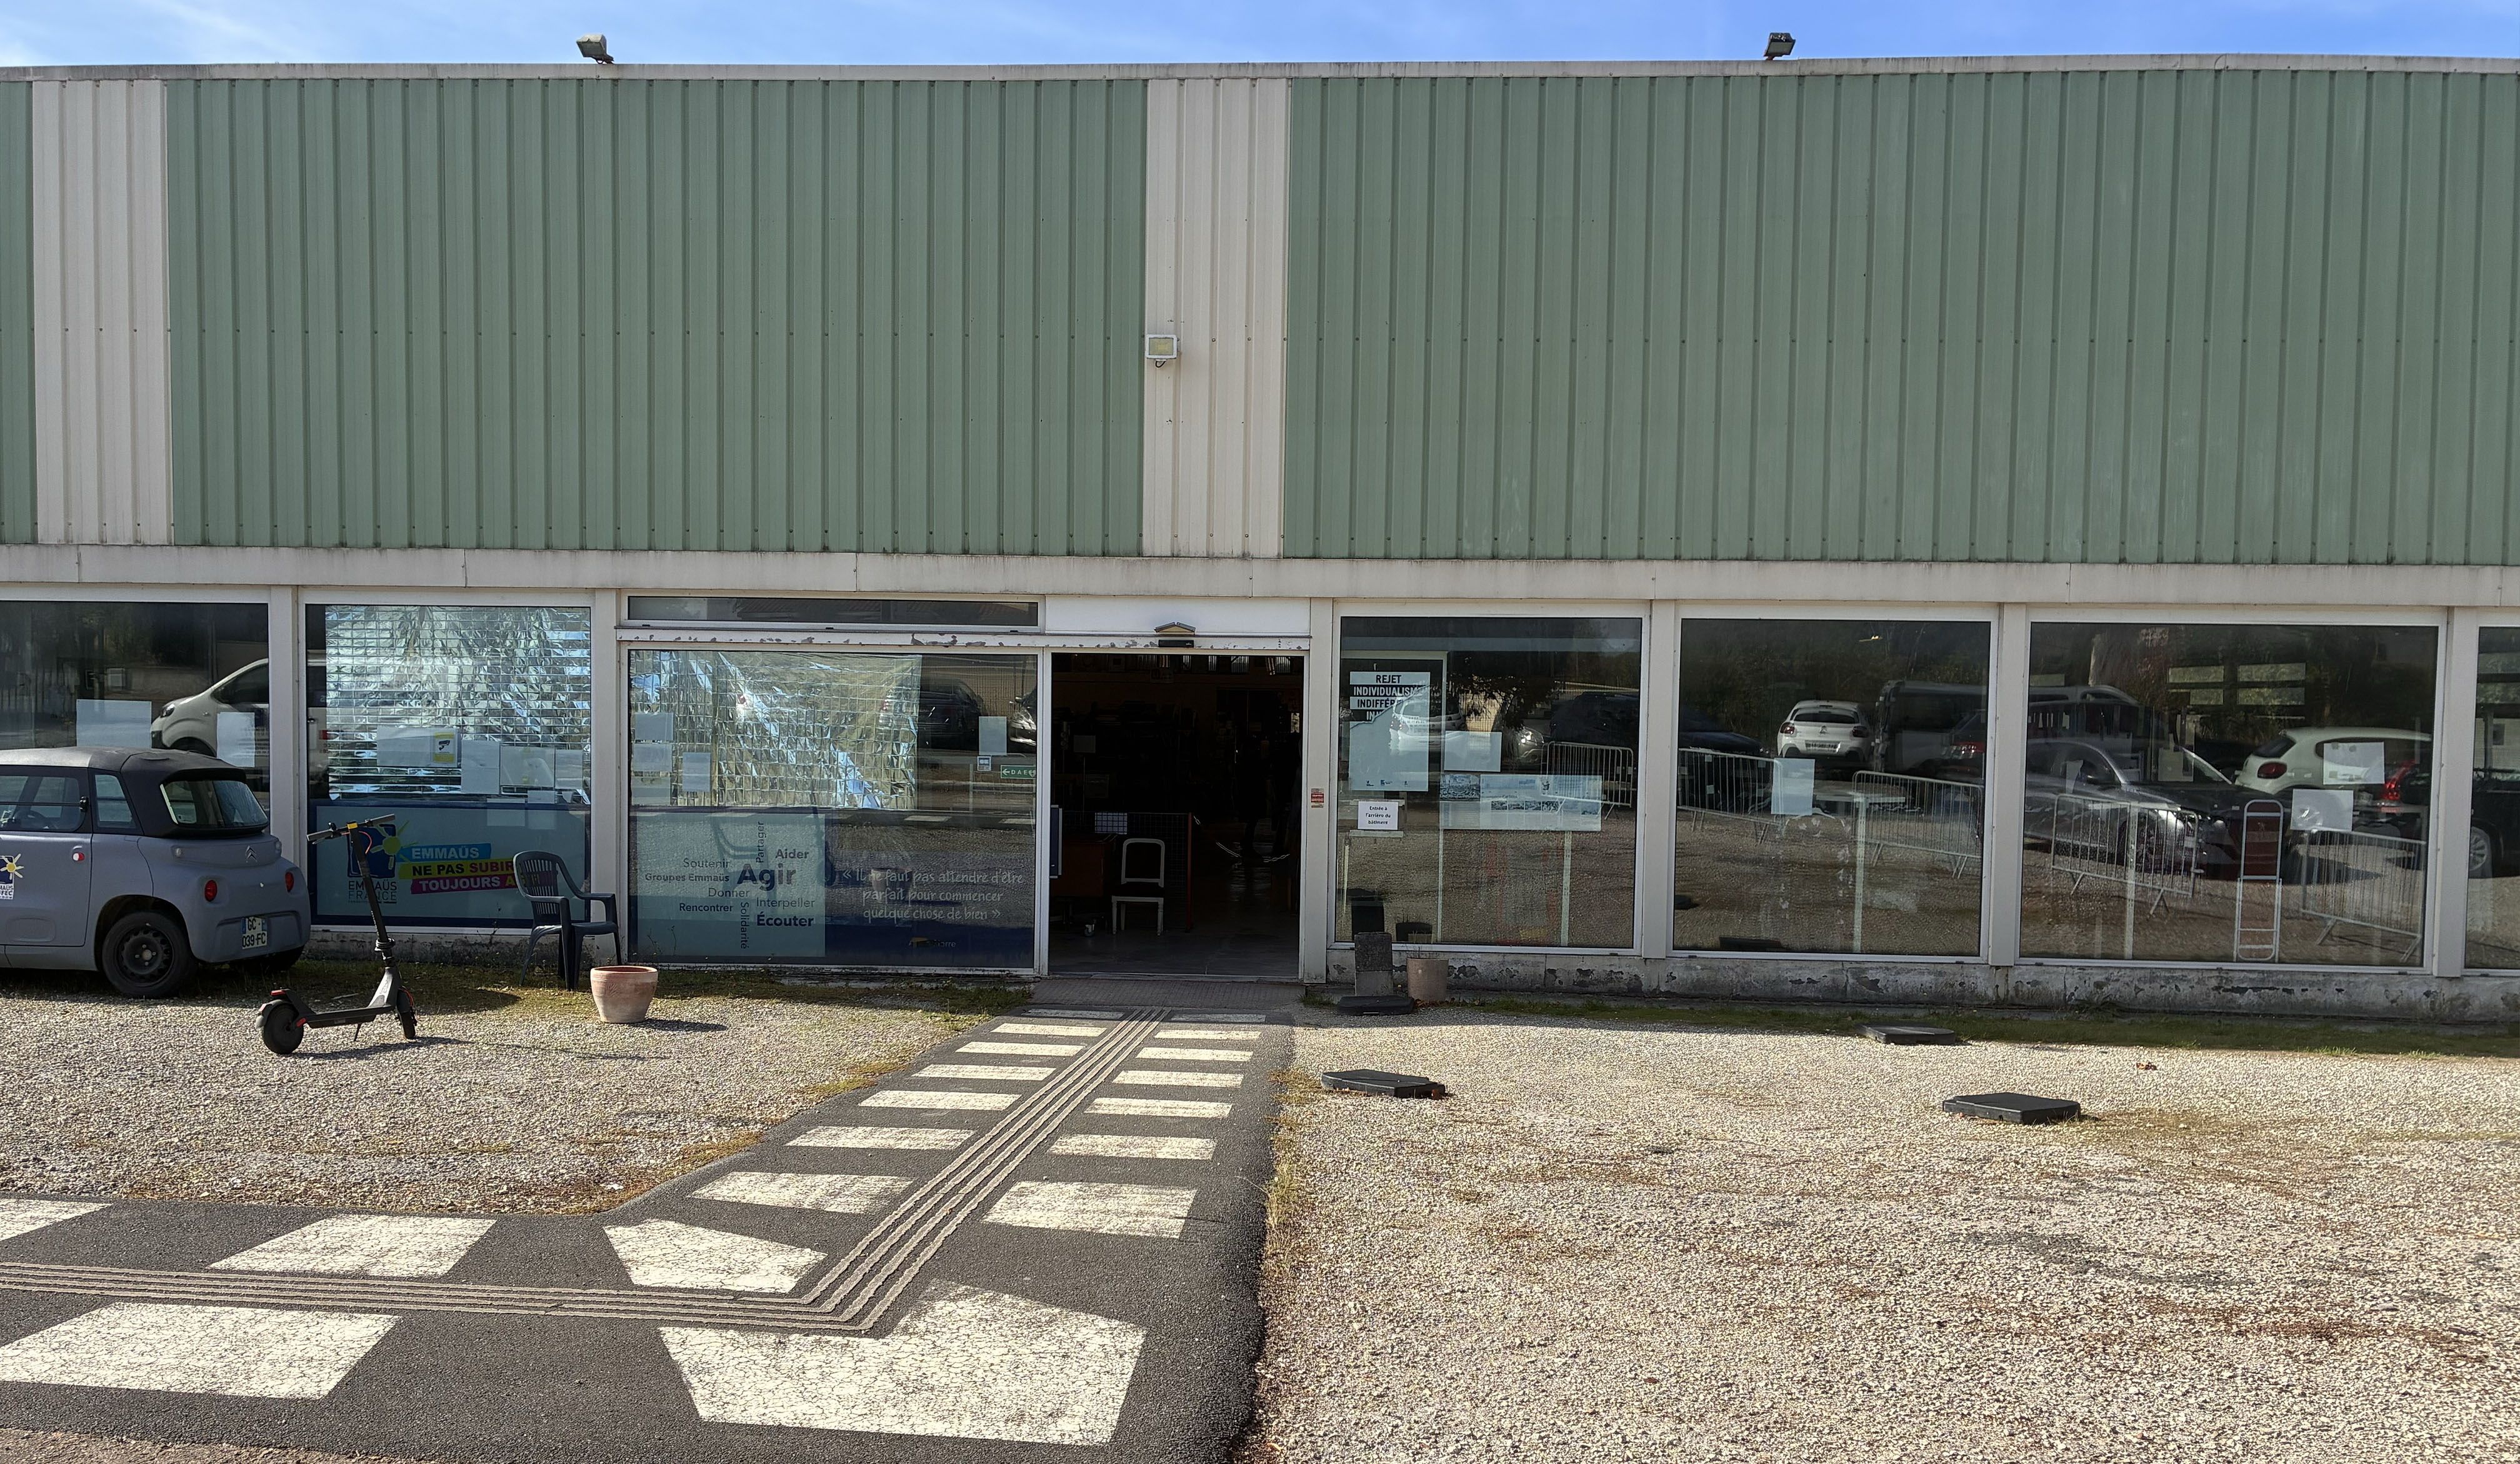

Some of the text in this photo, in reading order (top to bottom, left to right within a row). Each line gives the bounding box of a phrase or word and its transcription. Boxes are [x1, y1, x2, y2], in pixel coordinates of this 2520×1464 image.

[1376, 675, 1402, 684] REJET
[755, 821, 767, 863] Partager
[411, 845, 479, 859] EMMAÜS
[775, 849, 809, 859] Aider
[412, 861, 514, 876] NE PAS SUBIR
[683, 857, 730, 868] Soutenir
[419, 876, 501, 892] TOUJOURS
[645, 873, 730, 883] Groupes Emmaüs
[736, 862, 796, 892] Agir
[885, 869, 910, 887] faut
[912, 872, 935, 889] pas
[938, 870, 989, 884] attendre
[348, 879, 397, 891] EMAÜS
[708, 887, 750, 897] Donner
[348, 890, 397, 900] FRCE
[862, 887, 1004, 907] parfait pour commencer
[679, 903, 733, 912] Rencontrer
[756, 897, 815, 910] Interpeller
[756, 912, 814, 927] Écouter
[863, 906, 911, 924] quelque
[912, 907, 946, 920] chose
[947, 907, 962, 920] de
[964, 906, 988, 920] bien
[740, 902, 749, 949] Solidarité
